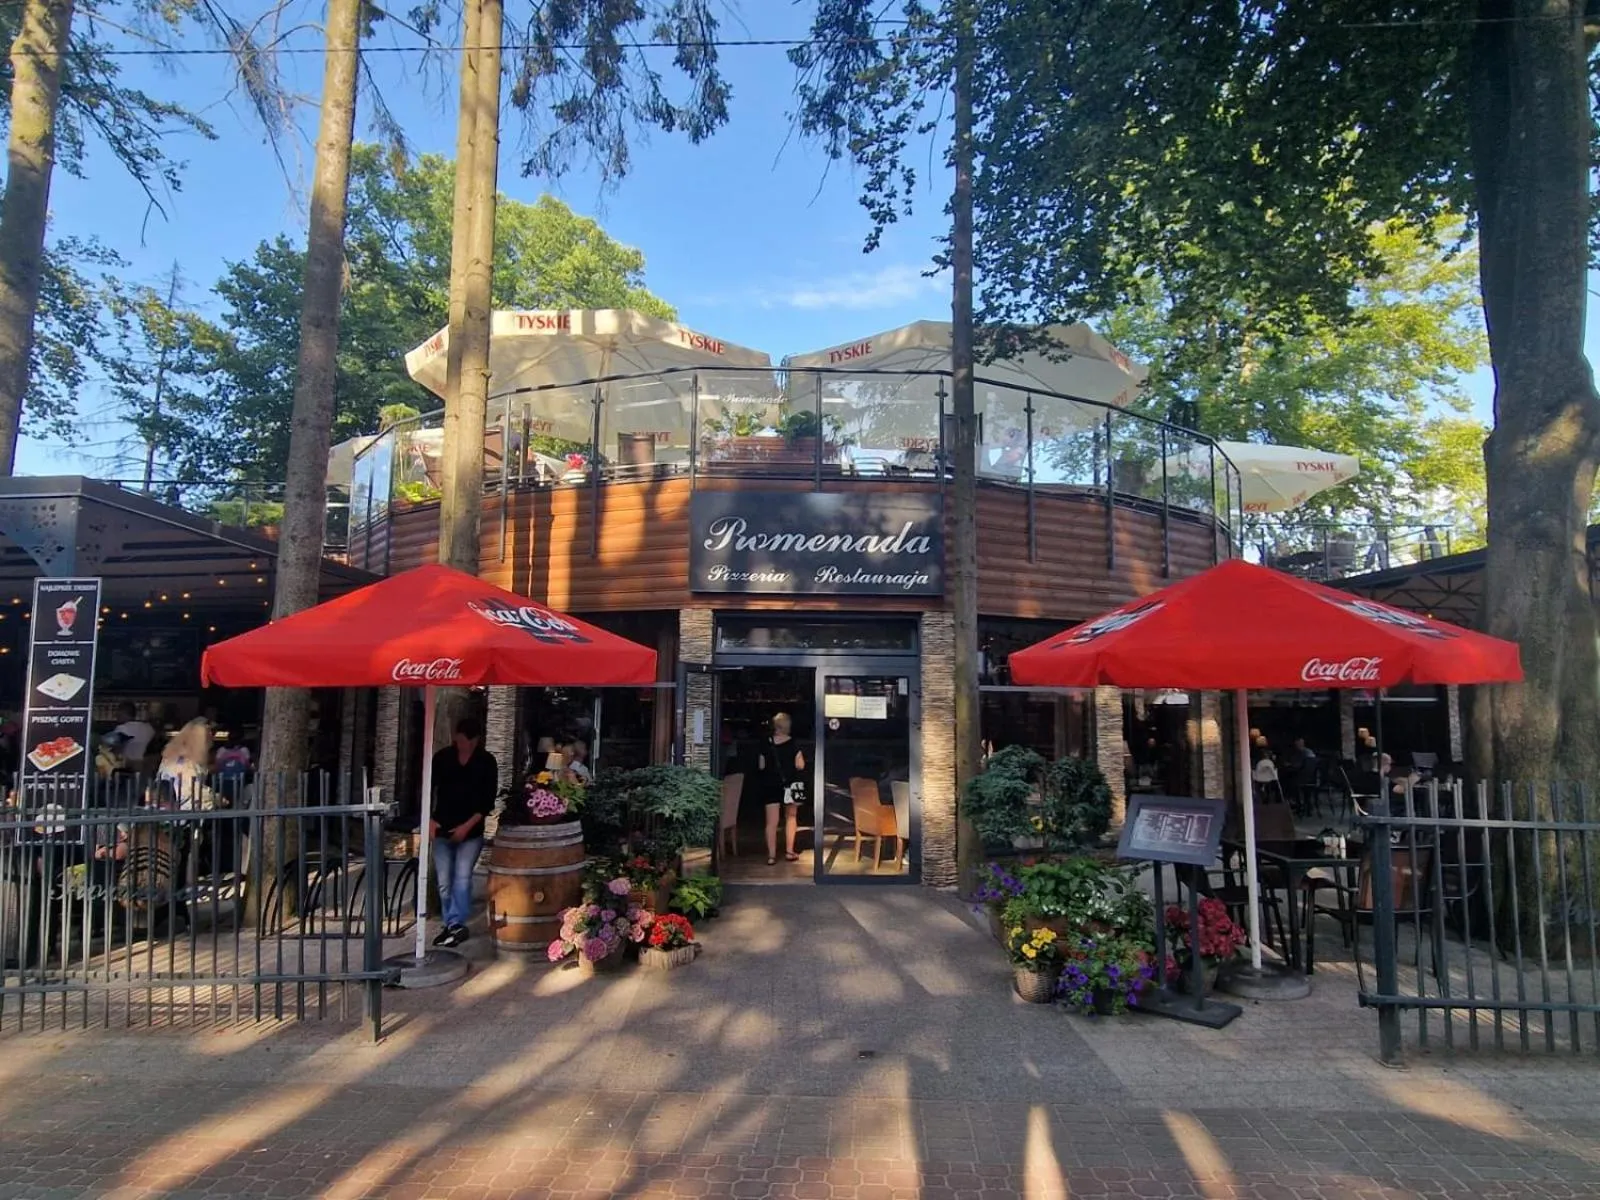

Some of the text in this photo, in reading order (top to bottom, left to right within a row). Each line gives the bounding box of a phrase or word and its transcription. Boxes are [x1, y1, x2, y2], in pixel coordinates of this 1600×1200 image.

[516, 314, 570, 329] TYSKIE
[678, 329, 725, 355] TYSKIE
[829, 342, 872, 364] TYSKIE
[1296, 462, 1336, 472] TYSKIE
[703, 516, 931, 553] Promenada
[707, 564, 929, 590] Pizzeria Restauracja
[392, 657, 464, 681] Coca-Cola
[1301, 656, 1383, 682] Coca-Cola
